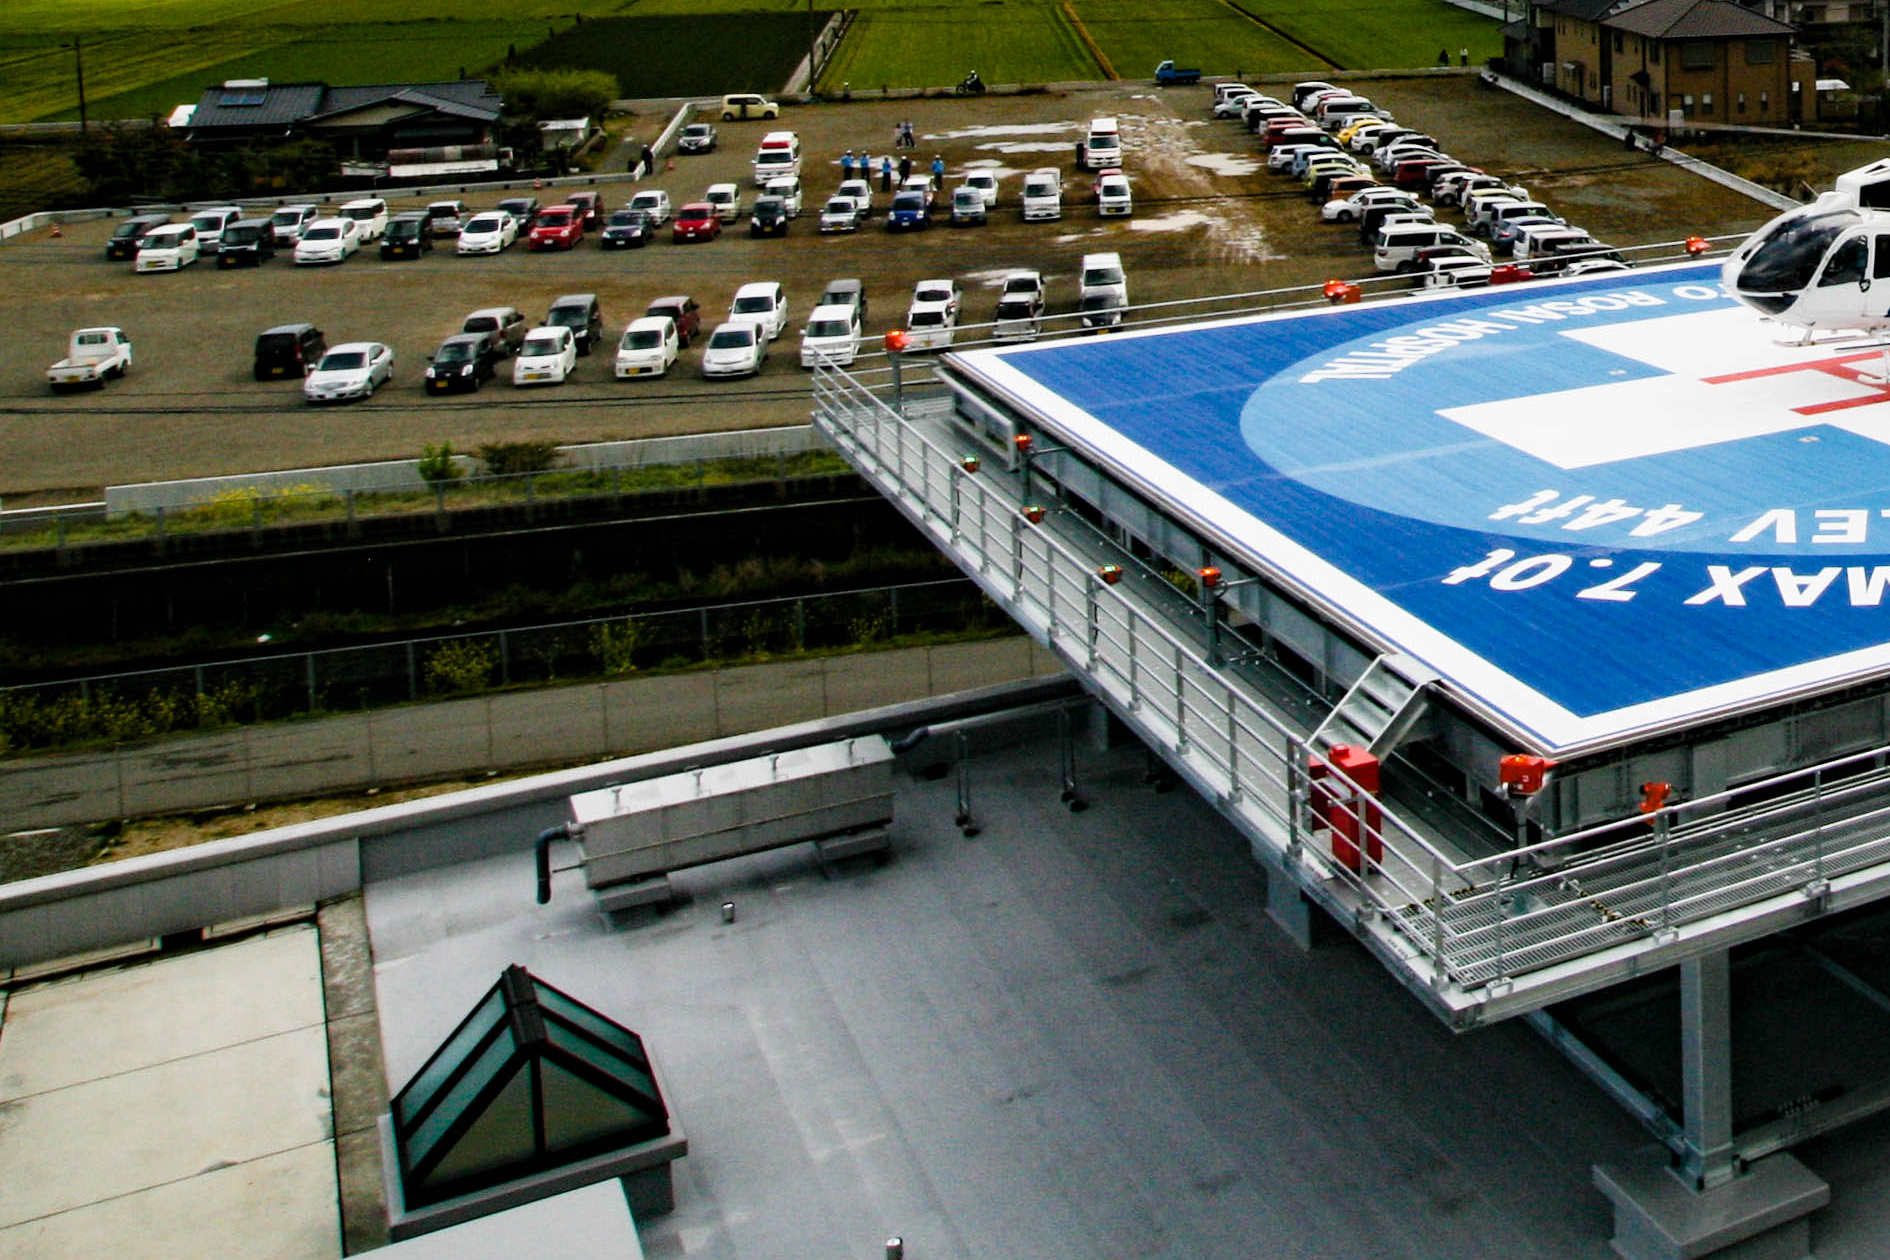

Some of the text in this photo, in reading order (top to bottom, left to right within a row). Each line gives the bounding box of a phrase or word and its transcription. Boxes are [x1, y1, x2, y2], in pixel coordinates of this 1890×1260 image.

[1488, 290, 1668, 332] ROSAI
[1298, 317, 1499, 384] HOSPITAL
[1487, 489, 1705, 538] 44ft
[1441, 548, 1663, 602] 7.0t
